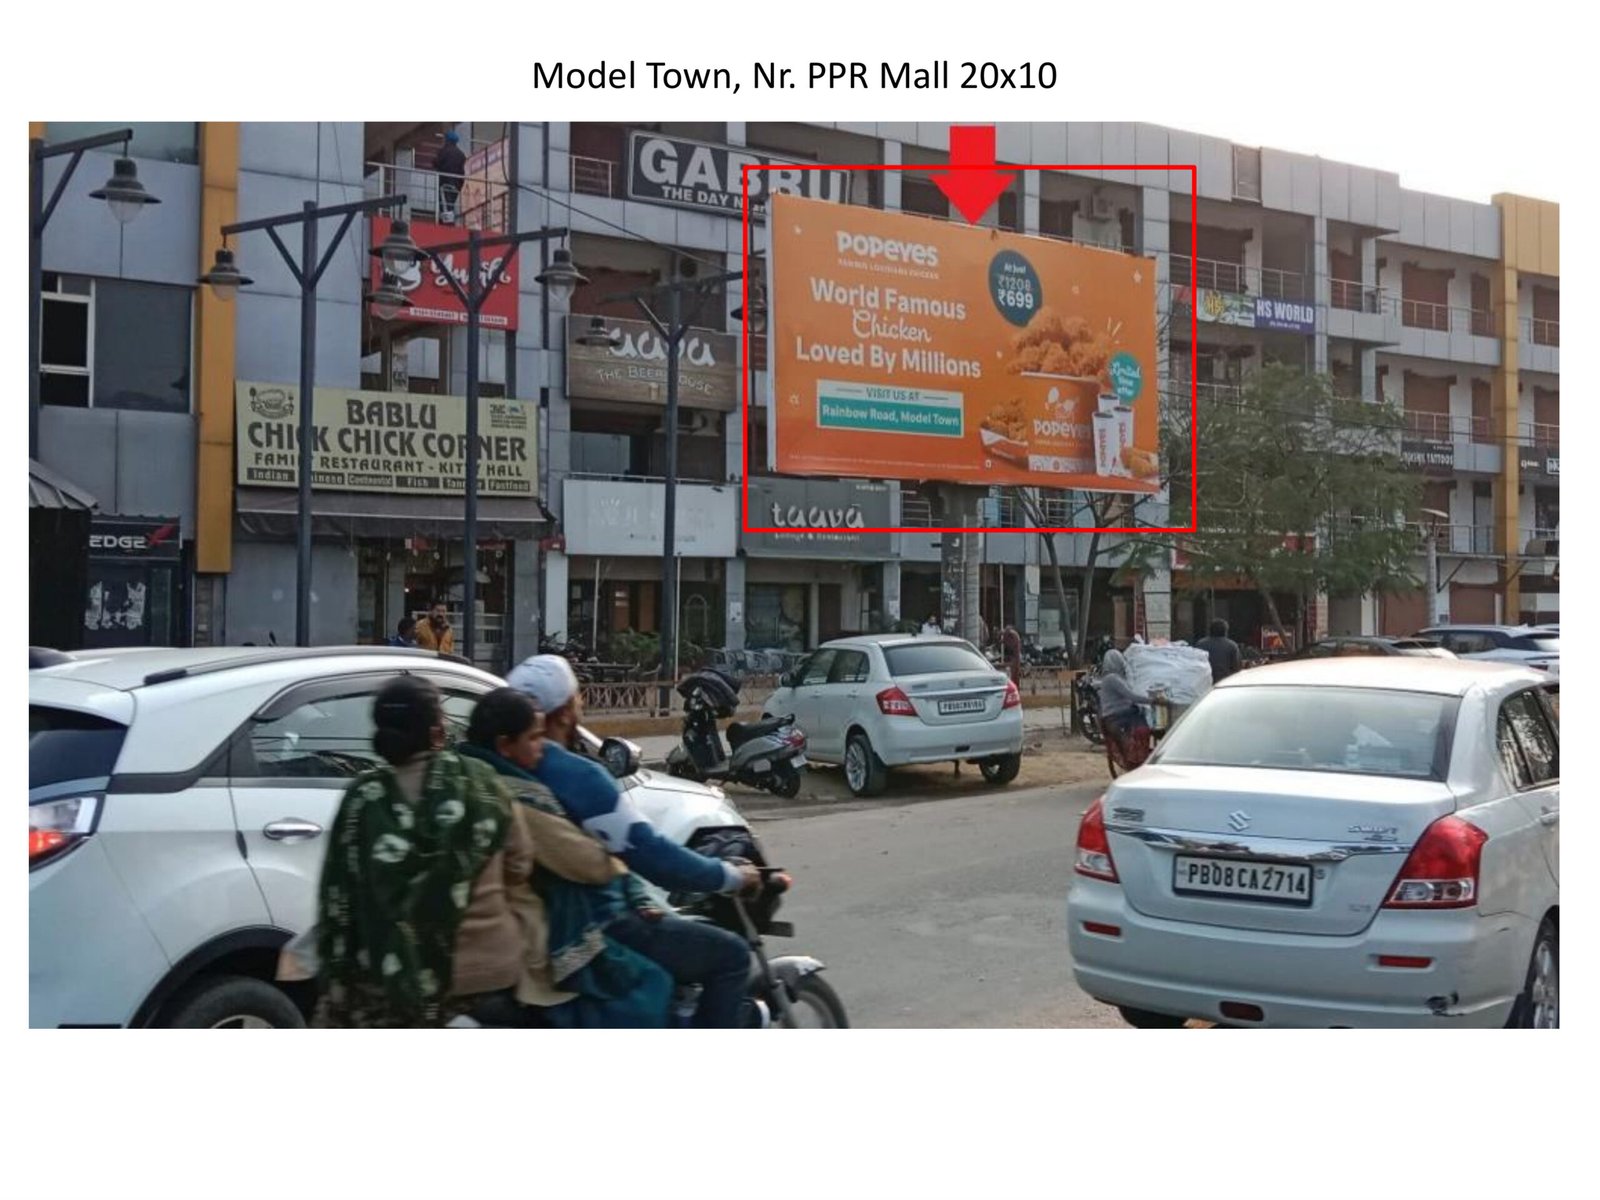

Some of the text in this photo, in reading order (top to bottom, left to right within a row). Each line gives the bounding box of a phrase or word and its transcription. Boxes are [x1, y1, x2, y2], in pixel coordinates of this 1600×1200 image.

[662, 185, 693, 201] THE
[697, 191, 730, 206] DAY
[811, 276, 967, 321] World Famous
[1256, 299, 1314, 324] HS WORLD
[852, 308, 932, 343] Chicken
[796, 336, 983, 378] Loved By Millions
[598, 369, 622, 384] THE
[866, 387, 920, 401] VISIT US AT
[346, 398, 437, 430] BABLU
[822, 404, 960, 427] Rainbow Road, Model Town
[337, 427, 417, 458] CHICK
[422, 432, 528, 462] CORNER
[254, 452, 314, 468] FAMI
[319, 456, 424, 474] RESTAURANT
[438, 461, 481, 475] KIT
[486, 463, 523, 477] HALL
[252, 469, 290, 481] Indian
[407, 477, 430, 488] Fish
[89, 534, 147, 549] EDGE
